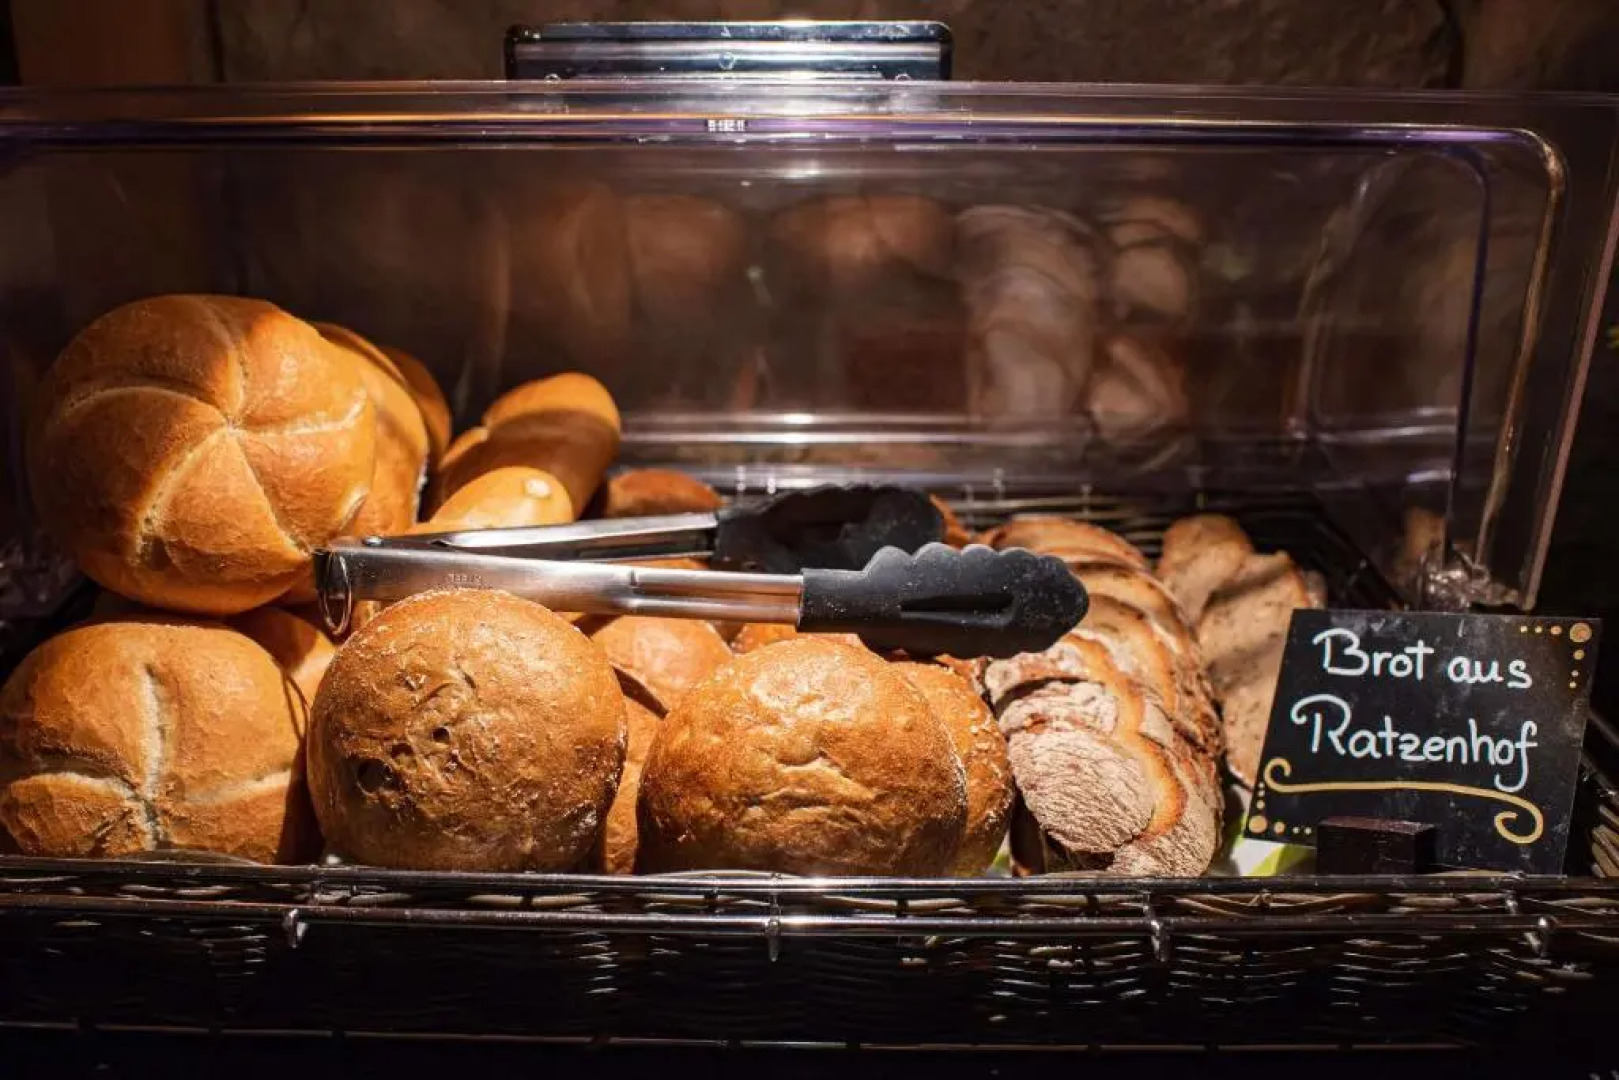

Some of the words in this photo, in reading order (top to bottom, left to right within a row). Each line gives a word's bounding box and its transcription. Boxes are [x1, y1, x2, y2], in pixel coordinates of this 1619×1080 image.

[1312, 627, 1435, 681] Brot
[1447, 655, 1533, 689] aus
[1290, 693, 1538, 793] Ratzenhof
